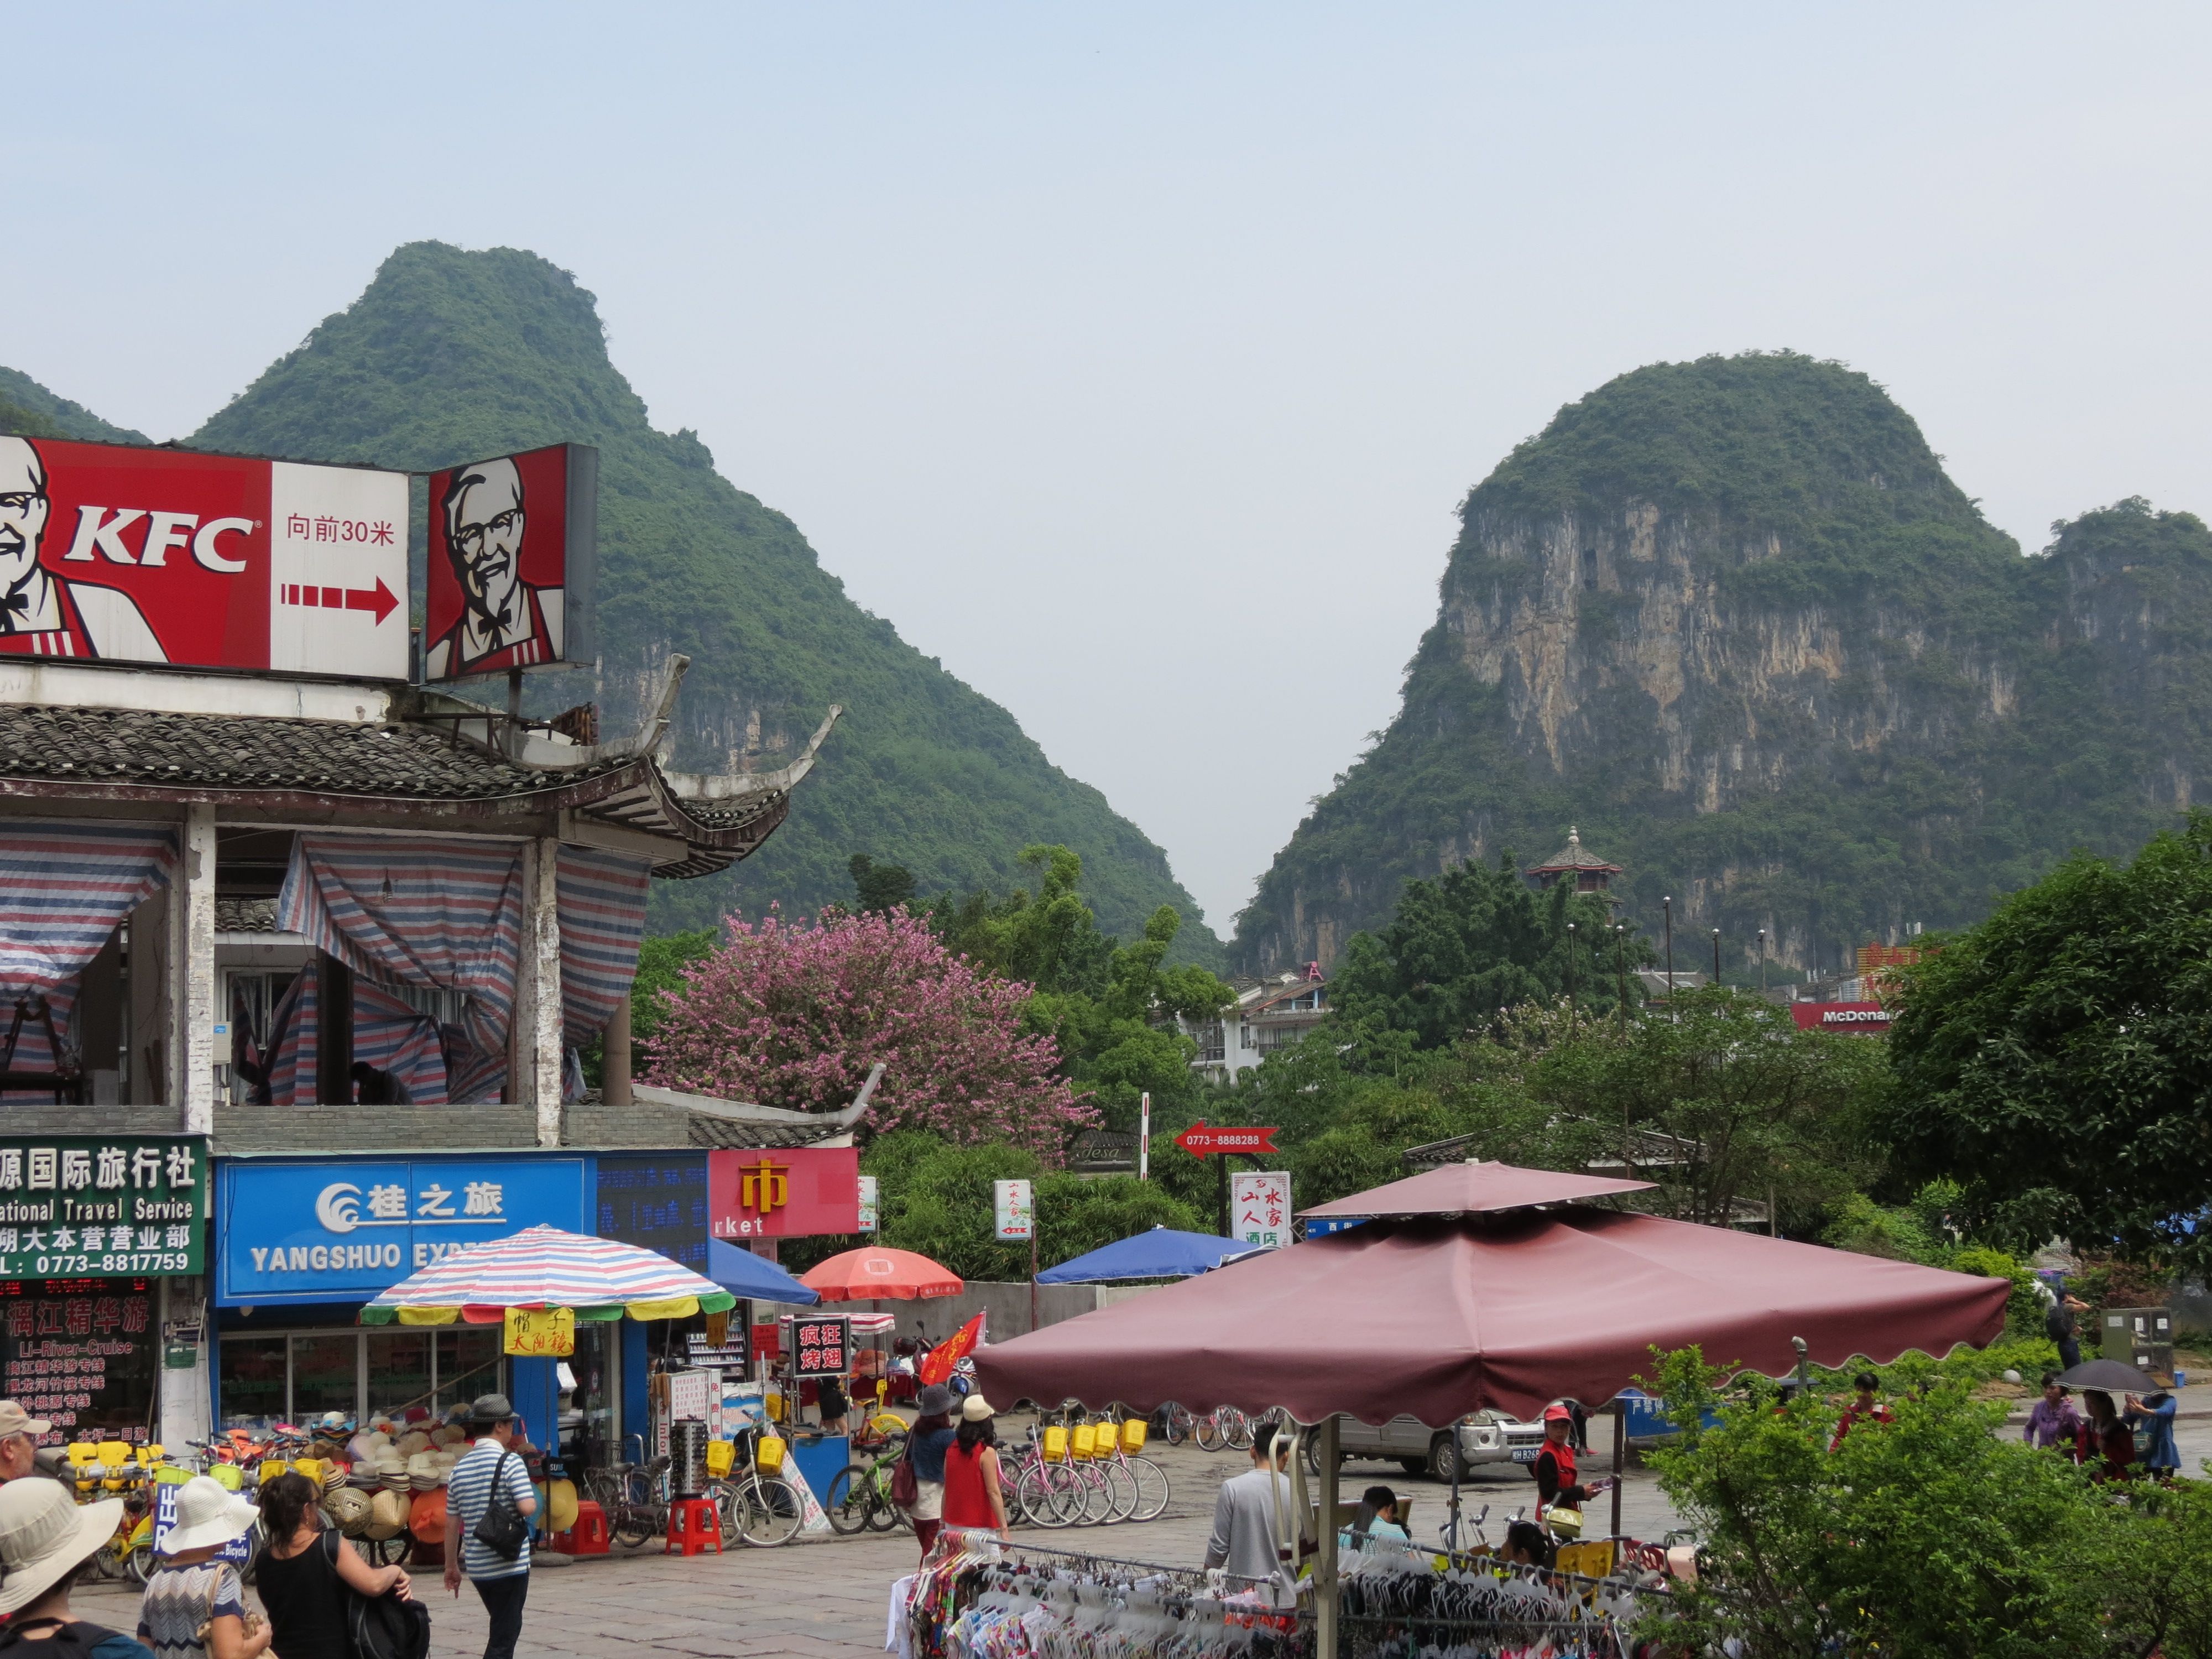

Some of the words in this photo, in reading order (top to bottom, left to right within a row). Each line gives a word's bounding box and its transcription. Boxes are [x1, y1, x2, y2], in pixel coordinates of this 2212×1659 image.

[64, 505, 254, 573] KFC
[286, 513, 395, 546] 向前30米
[1187, 1135, 1260, 1145] 0773-8888288
[0, 1146, 195, 1190] 源国际旅行社
[739, 1160, 790, 1213] 市
[64, 1197, 123, 1221] Travel
[135, 1197, 193, 1220] Service
[367, 1181, 503, 1218] 桂之旅
[1008, 1183, 1020, 1217] 山水人家
[714, 1217, 763, 1234] rket
[0, 1225, 190, 1253] 朔大本营营业部
[1246, 1232, 1277, 1245] 酒店
[36, 1253, 188, 1274] 0773-8817759
[251, 1243, 401, 1272] YANGSHUO
[7, 1297, 149, 1337] 漓江精华游
[800, 1324, 841, 1345] 疯狂
[20, 1339, 133, 1358] Li-River-Cruise
[800, 1348, 842, 1370] 烤翅
[5, 1358, 106, 1376] 漓江精华游专线
[4, 1375, 106, 1393] 遇龙河竹筏专线
[1522, 1449, 1540, 1459] B268
[225, 1544, 247, 1559] Bicycle
